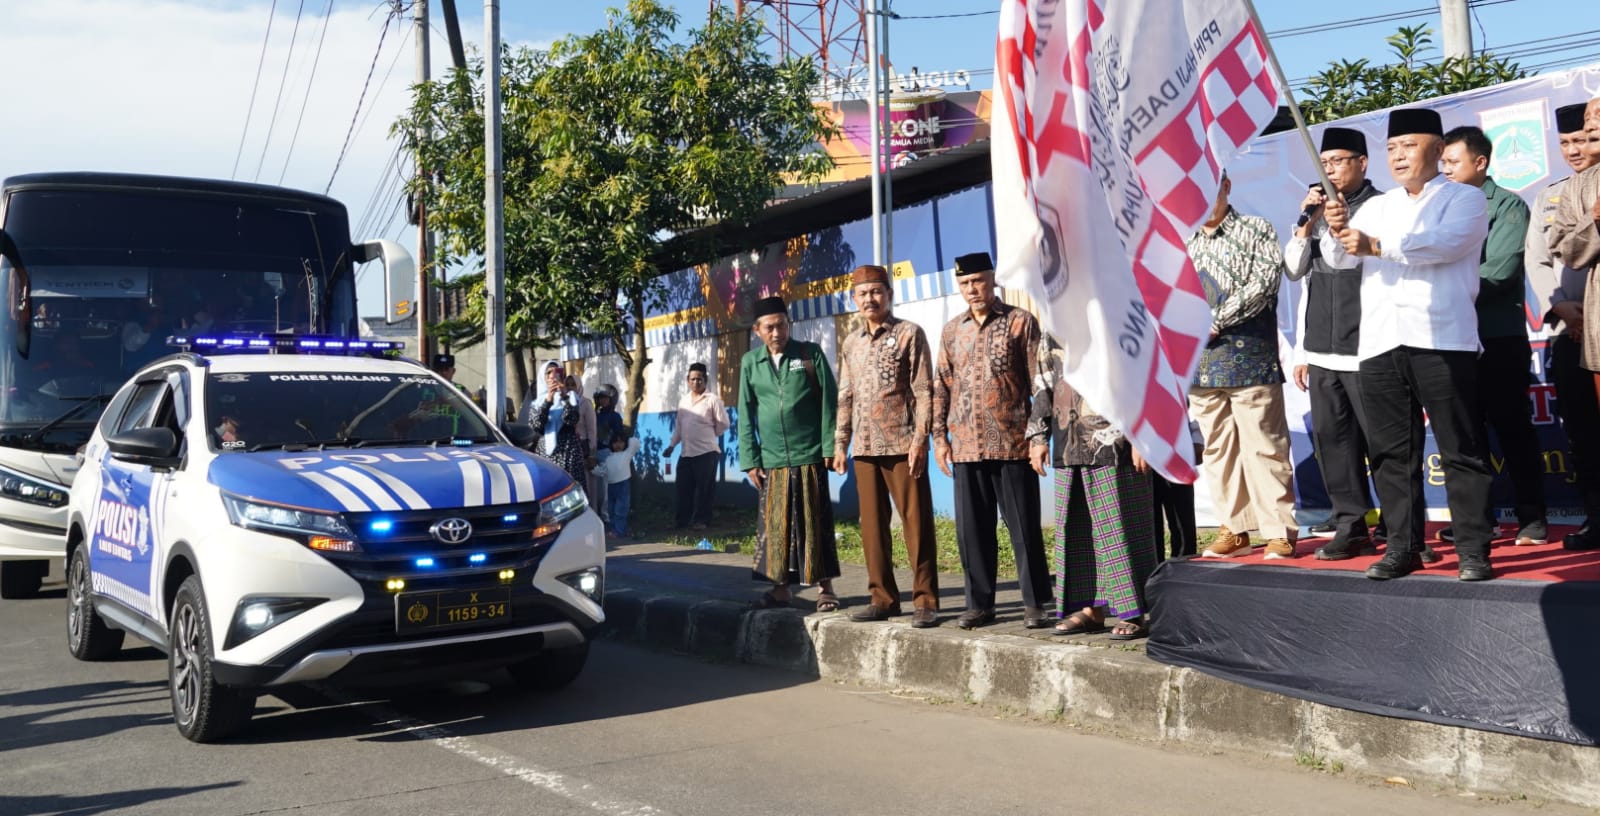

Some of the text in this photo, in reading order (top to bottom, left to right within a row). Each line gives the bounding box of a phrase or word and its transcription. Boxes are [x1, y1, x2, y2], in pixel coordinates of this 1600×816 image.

[269, 374, 439, 385] POLRES MALANG 34-002
[277, 450, 515, 471] POLISI
[96, 499, 139, 547] POLISI
[469, 592, 478, 603] X
